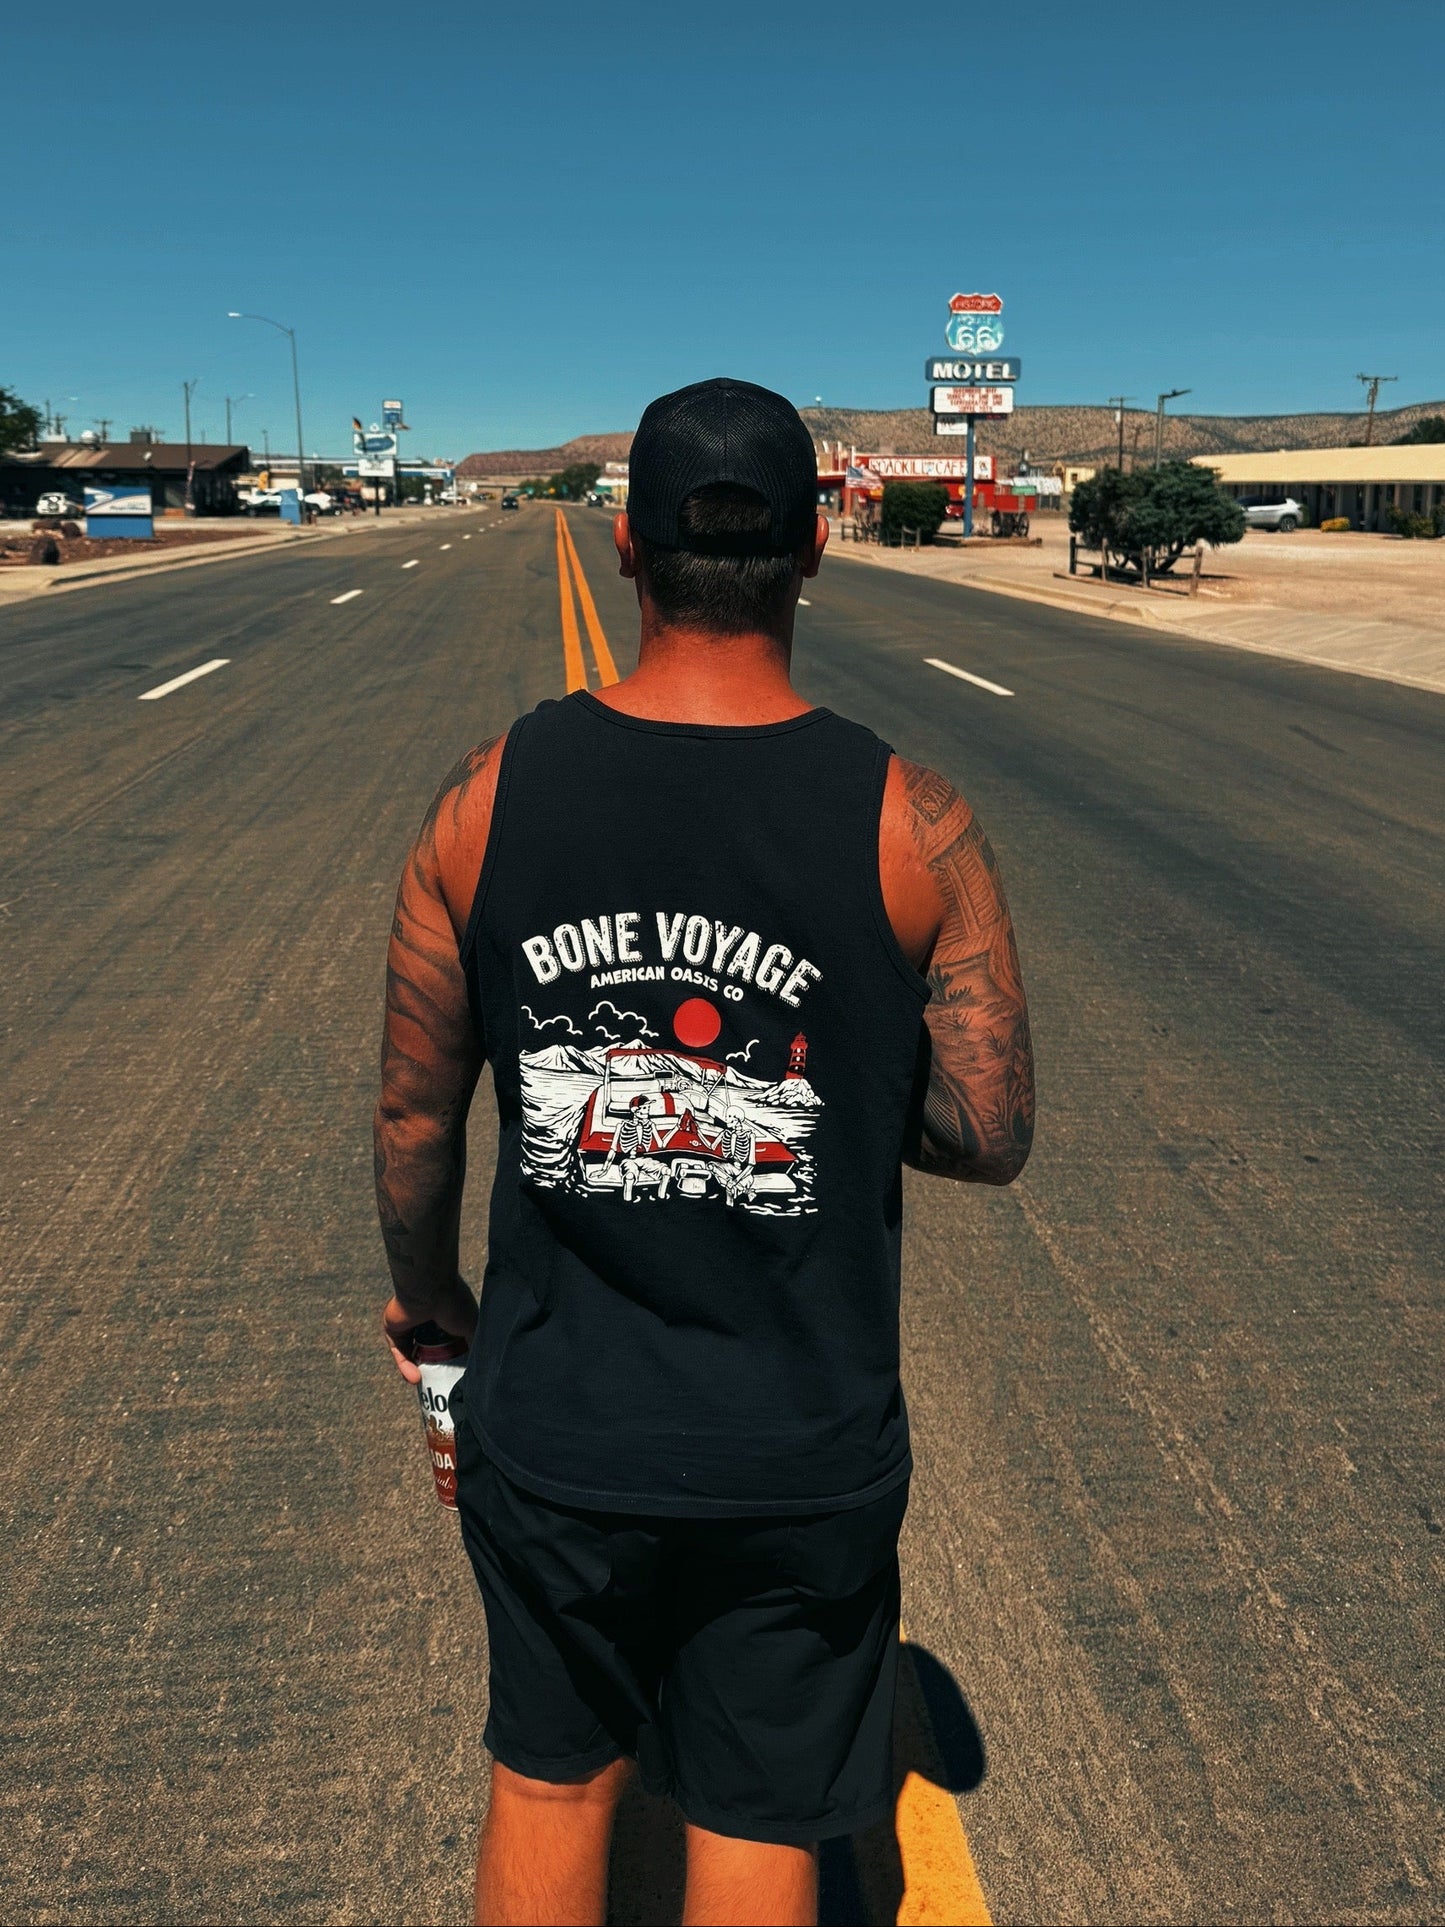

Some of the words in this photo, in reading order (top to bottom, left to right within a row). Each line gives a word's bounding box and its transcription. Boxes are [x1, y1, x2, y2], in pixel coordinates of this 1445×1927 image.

[956, 326, 995, 351] 66
[933, 362, 1016, 379] MOTEL
[935, 461, 967, 475] CAFE
[521, 911, 643, 984] BONE
[656, 911, 822, 1007] VOYAGE
[590, 966, 665, 989] AMERICAN
[671, 966, 718, 992] OASIS
[723, 985, 744, 1001] CO
